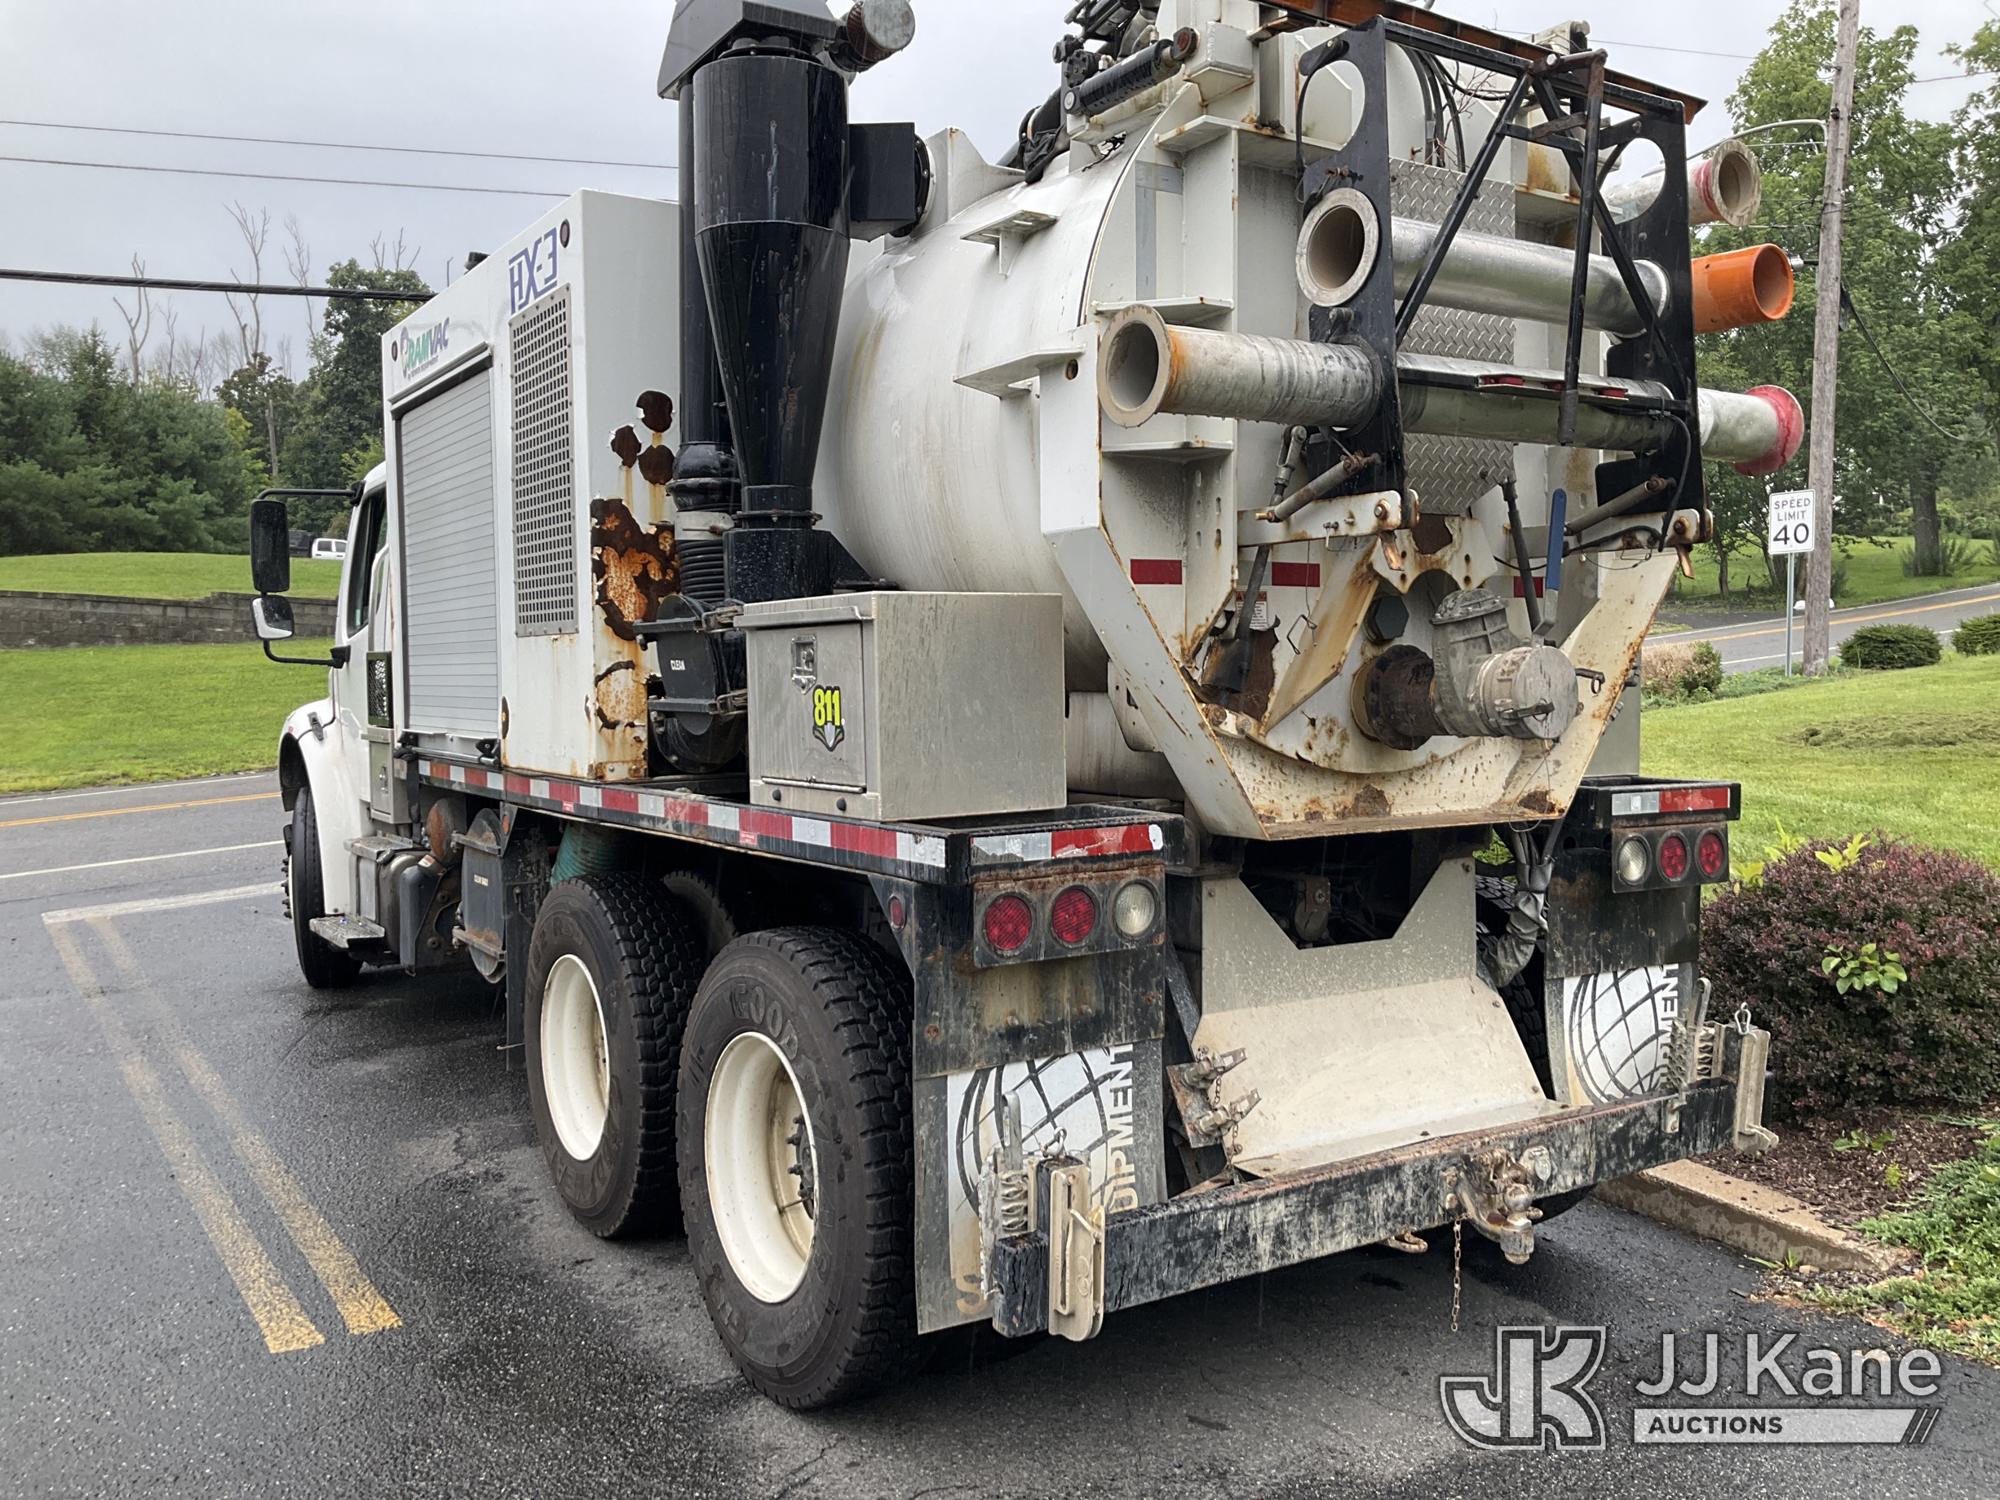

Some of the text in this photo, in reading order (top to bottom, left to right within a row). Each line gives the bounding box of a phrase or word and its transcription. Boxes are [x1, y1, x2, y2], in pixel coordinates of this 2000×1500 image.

[1774, 498, 1811, 510] SPEED
[1777, 510, 1806, 521] LIMIT
[1773, 522, 1809, 545] 40
[813, 685, 841, 727] 811
